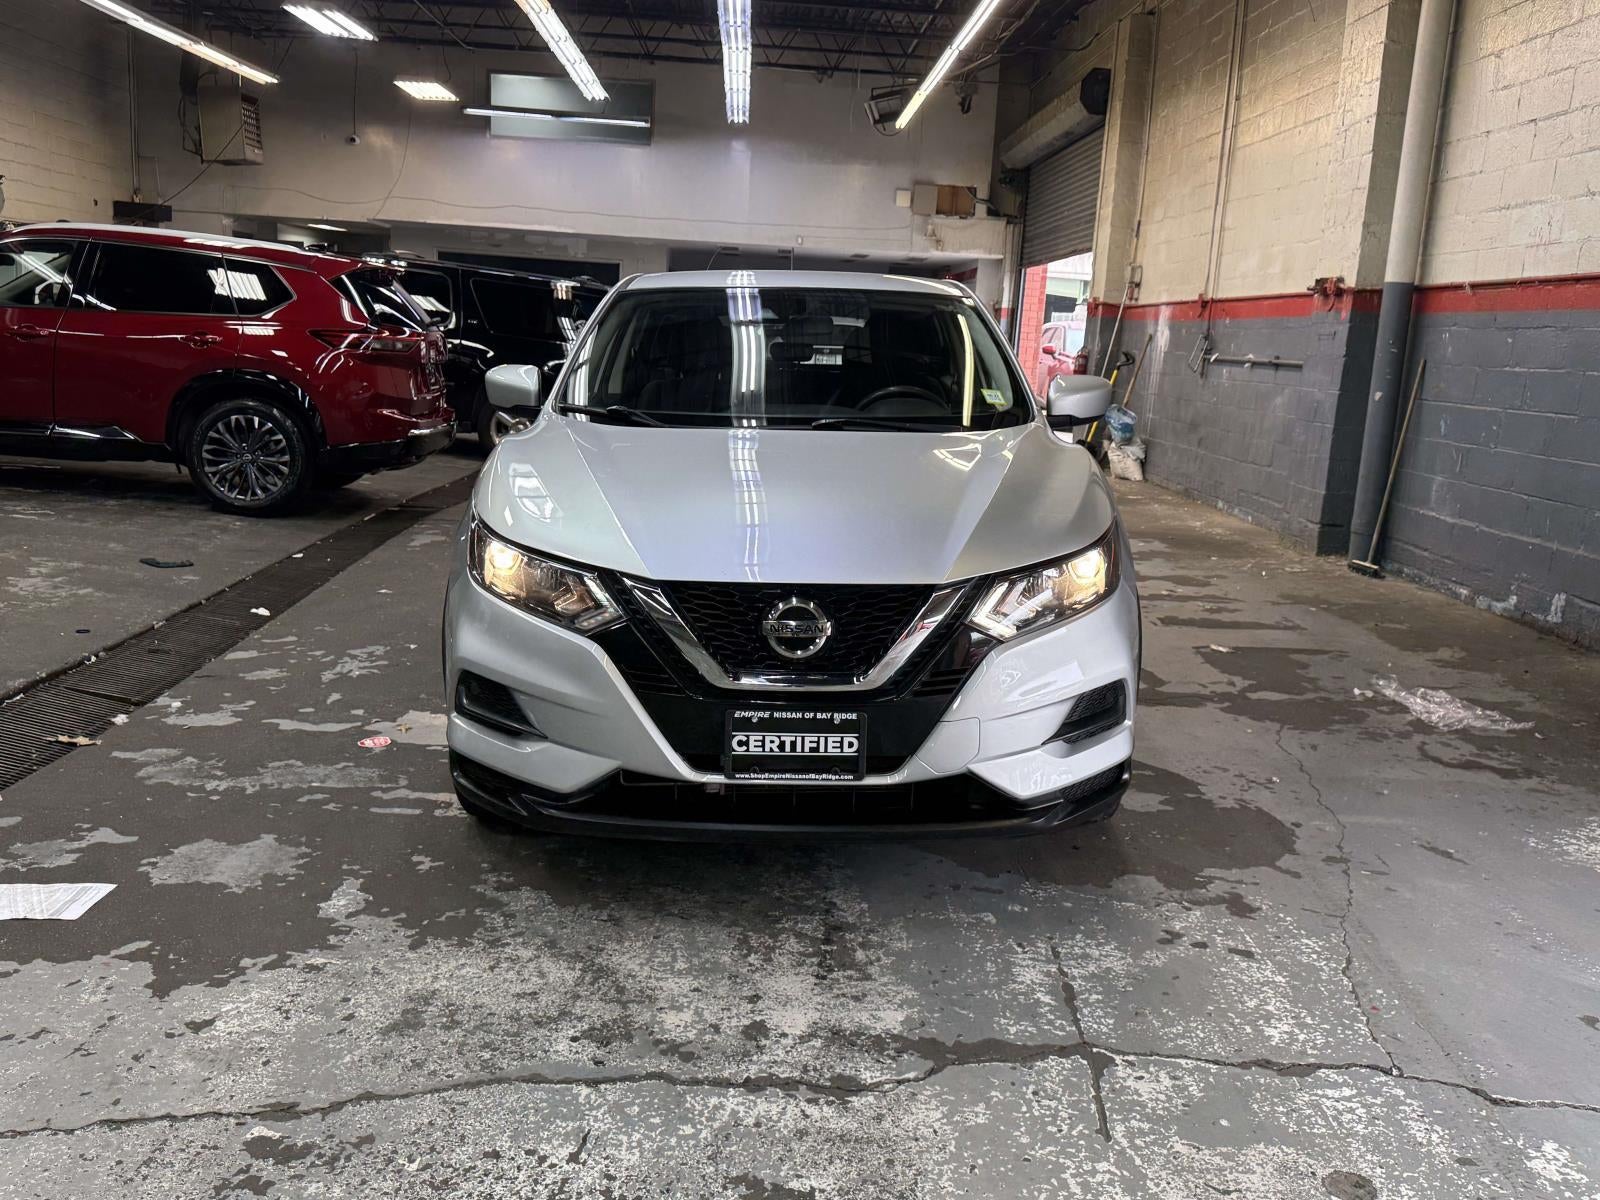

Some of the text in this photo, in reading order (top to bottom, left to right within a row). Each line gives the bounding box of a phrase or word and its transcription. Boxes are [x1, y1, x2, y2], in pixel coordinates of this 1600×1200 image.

[769, 624, 824, 634] NISSAN
[734, 710, 771, 718] EMPIRE
[773, 711, 802, 719] NISSAN
[816, 712, 832, 720] BAY
[833, 712, 858, 720] RIDGE
[731, 735, 859, 753] CERTIFIED
